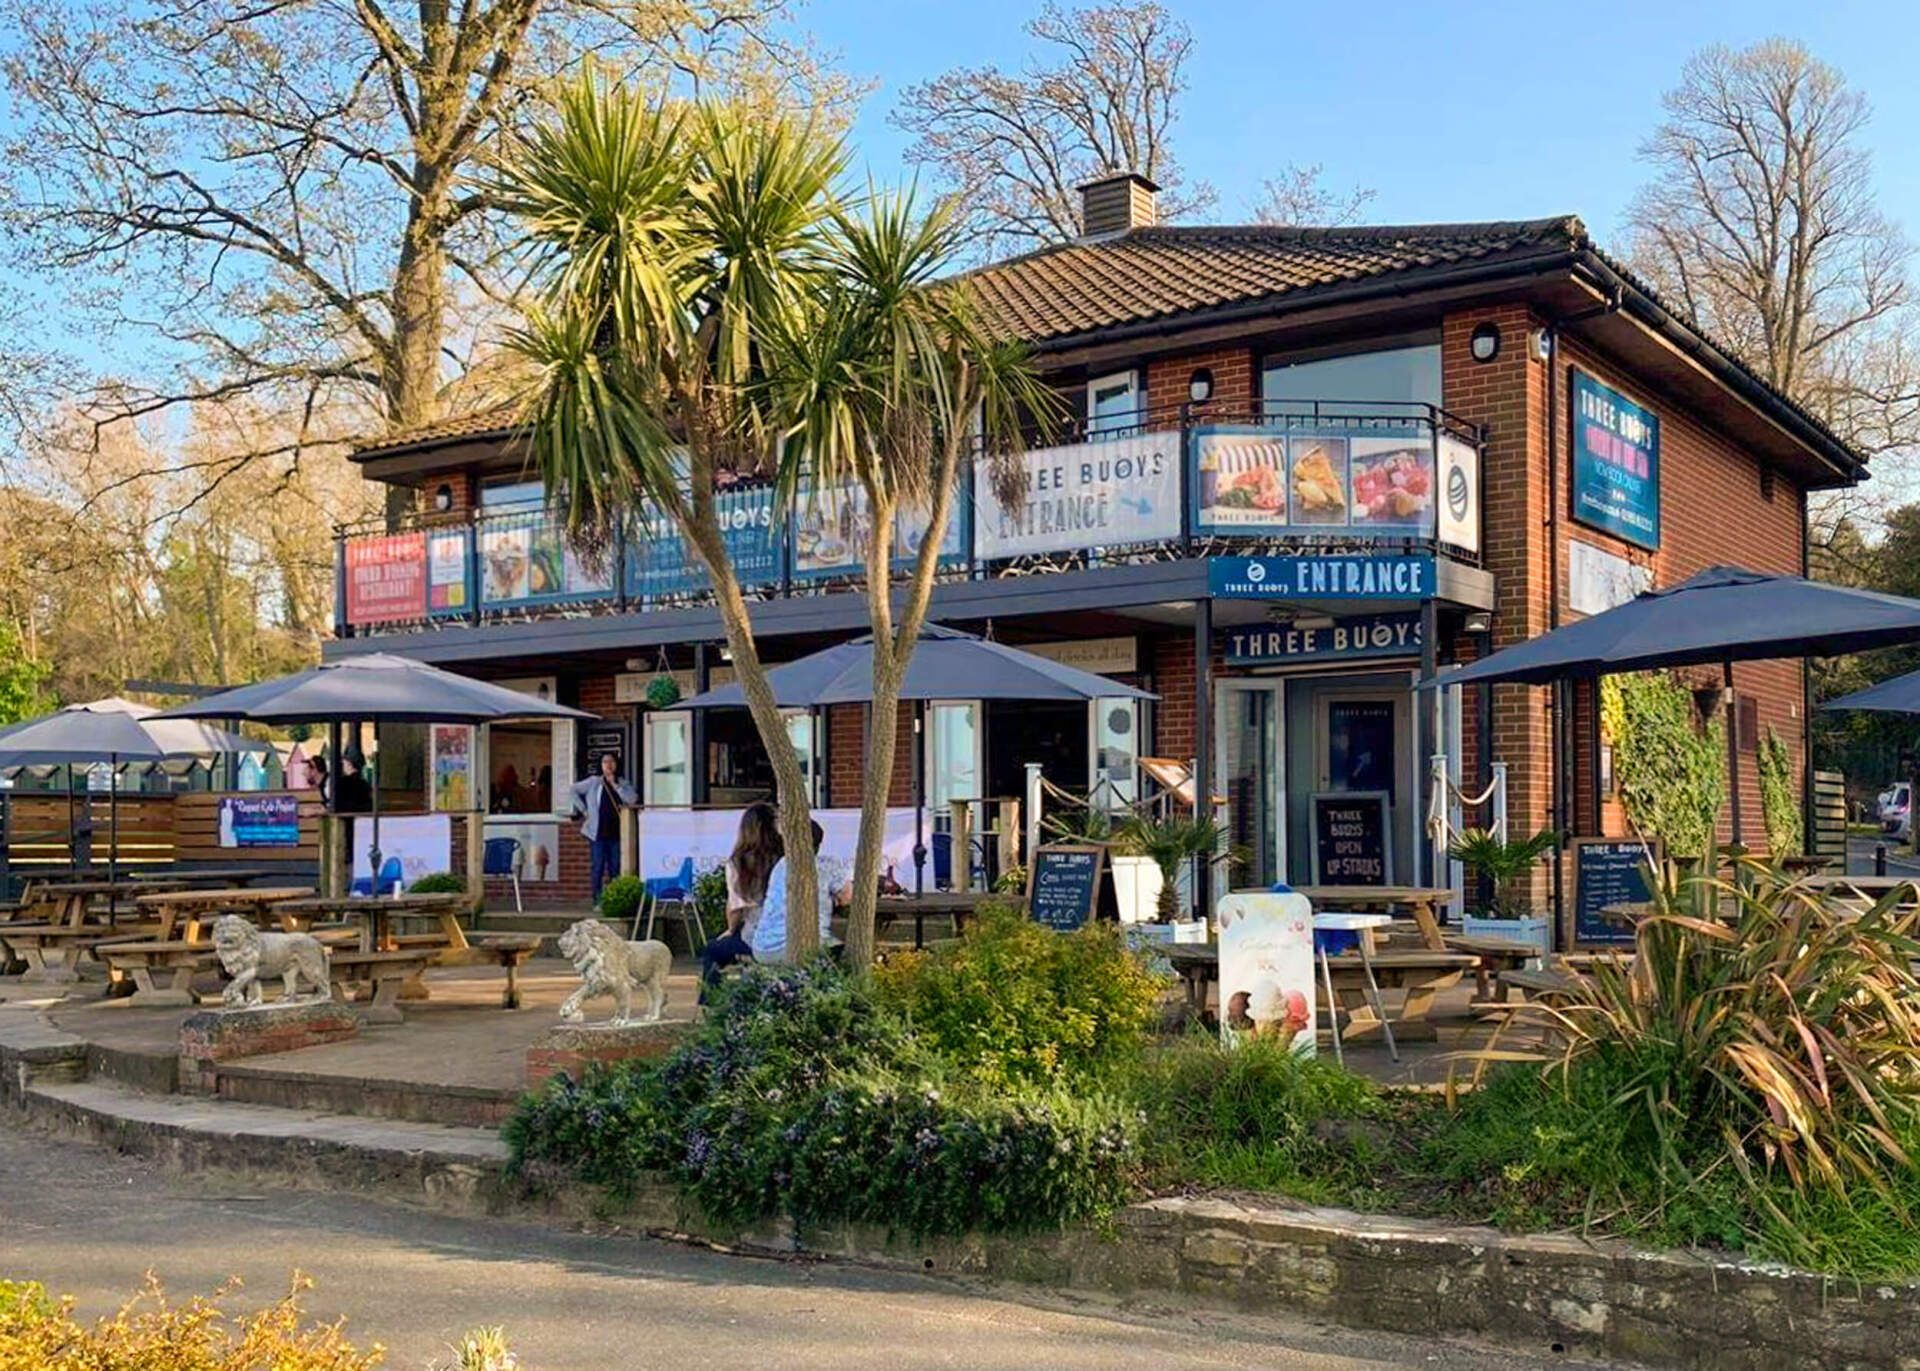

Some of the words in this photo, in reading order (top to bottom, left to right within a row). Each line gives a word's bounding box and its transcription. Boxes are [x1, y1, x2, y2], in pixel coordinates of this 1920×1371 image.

[1581, 388, 1616, 430] THREE
[1619, 409, 1652, 450] BUOYS
[1081, 452, 1164, 485] BUOYS
[718, 505, 771, 532] UOYS
[1224, 583, 1254, 593] THREE
[1257, 583, 1289, 595] BUOYS
[1297, 562, 1422, 595] ENTRANCE
[1233, 629, 1317, 657] THREE
[1333, 620, 1422, 651] BUOYS
[1327, 809, 1363, 822] THREE
[1330, 822, 1365, 838] BUOYS
[1335, 840, 1363, 855] OPEN
[1327, 859, 1341, 876] UP
[1342, 857, 1382, 877] STAIRS
